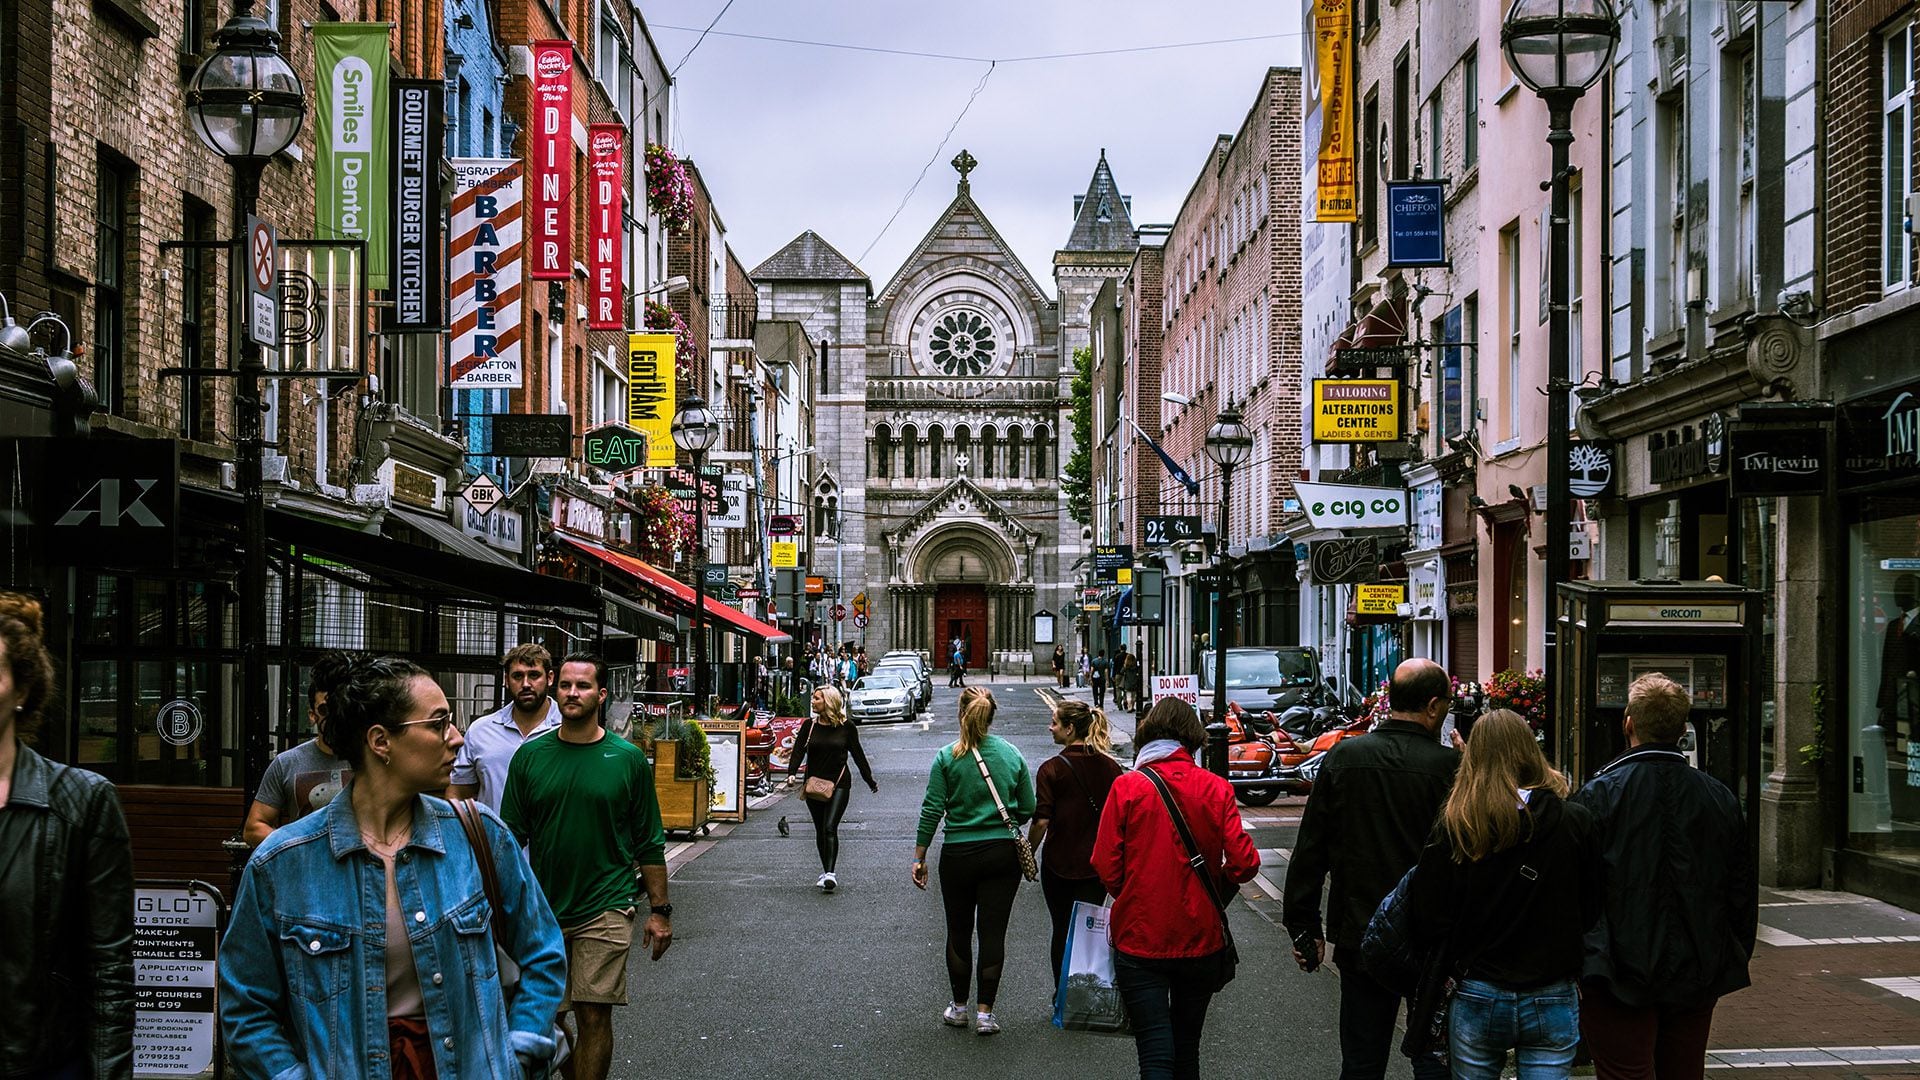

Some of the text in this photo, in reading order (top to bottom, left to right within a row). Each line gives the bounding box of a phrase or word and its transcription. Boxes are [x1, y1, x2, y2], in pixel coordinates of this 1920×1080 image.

[1330, 40, 1344, 154] ALTERATION
[341, 69, 365, 235] Smiles Dental
[466, 166, 518, 177] GRAFTON
[1320, 161, 1352, 184] CENTRE
[467, 179, 513, 189] BARBER
[543, 107, 560, 269] DINER
[402, 88, 422, 324] GOURMET BURGER KITCHEN
[1394, 203, 1437, 212] CHIFFON
[598, 181, 613, 321] DINER
[473, 195, 500, 358] BARBER
[465, 360, 517, 370] GRAFTON
[467, 373, 512, 382] BARBER
[630, 350, 671, 420] GOTHAM
[1327, 387, 1387, 398] TAILORING
[1322, 403, 1394, 415] ALTERATIONS
[1336, 417, 1378, 429] CENTRE
[1322, 430, 1393, 438] LADIES & GENTS
[588, 435, 641, 465] EAT
[694, 466, 722, 475] INES
[722, 480, 742, 491] METIC
[472, 489, 494, 500] GBK
[1160, 678, 1190, 689] DO NOT
[1177, 692, 1197, 703] THIS
[137, 898, 207, 912] GLOT
